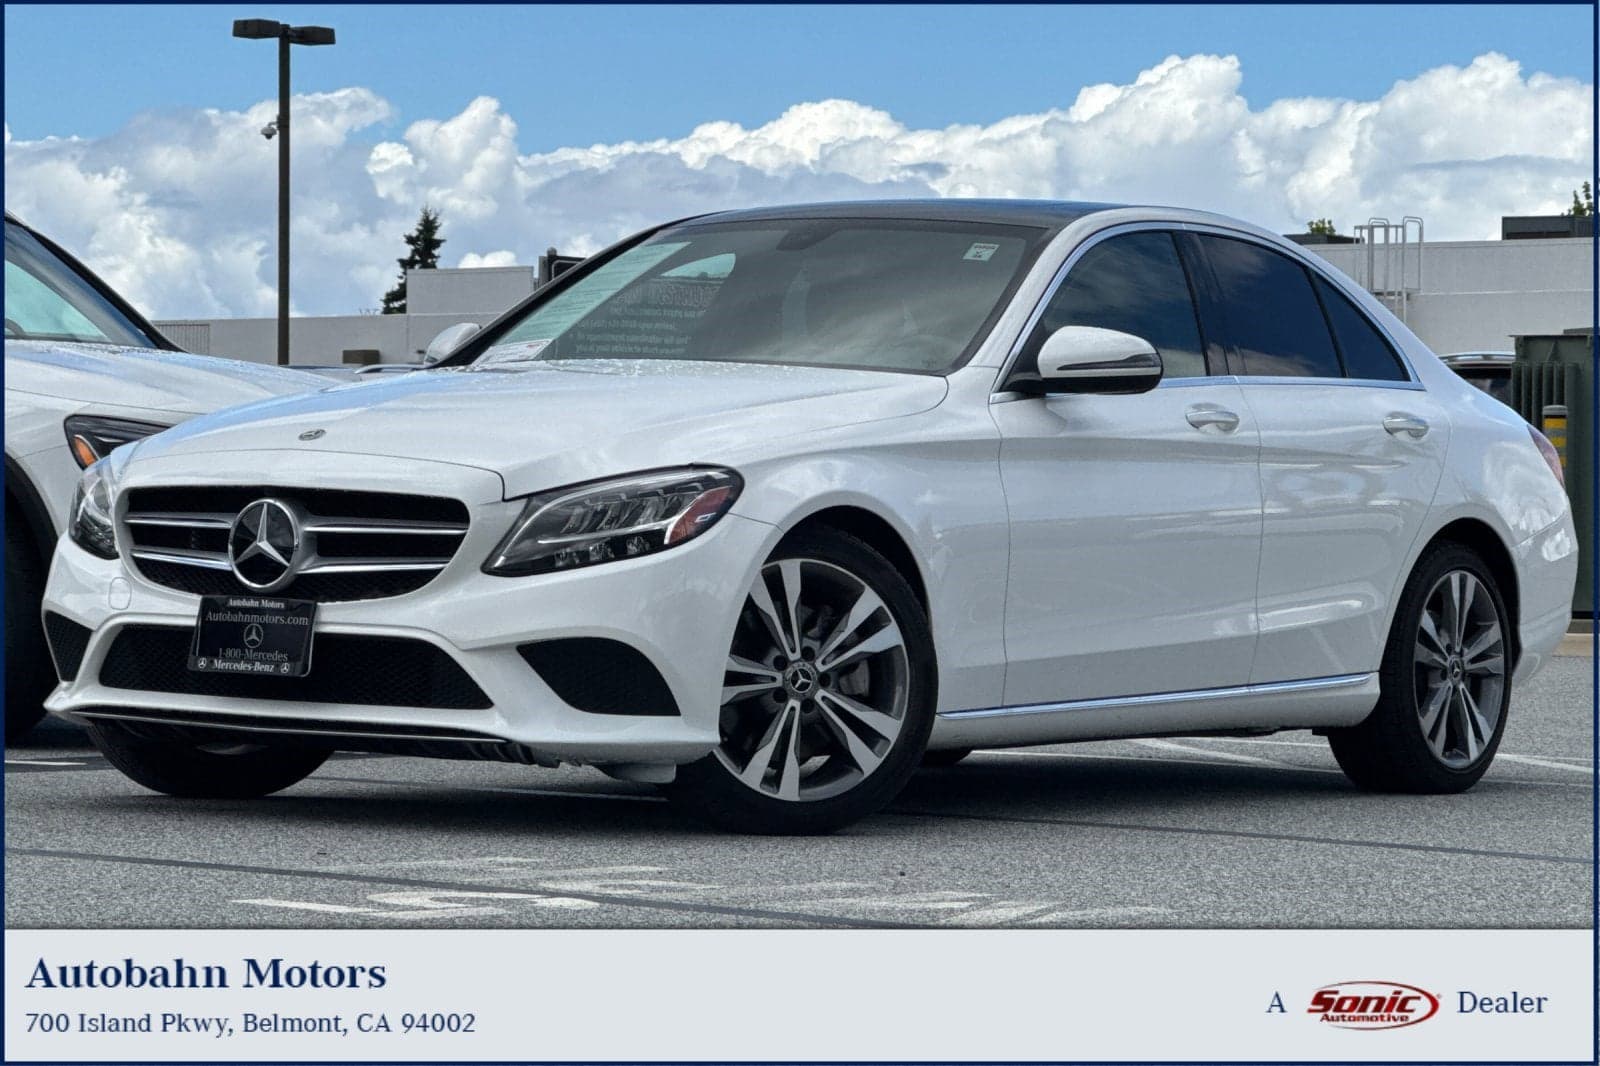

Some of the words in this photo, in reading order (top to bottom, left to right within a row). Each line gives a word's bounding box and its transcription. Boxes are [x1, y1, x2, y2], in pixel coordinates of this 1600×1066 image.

[228, 598, 260, 608] Autobahn
[261, 599, 285, 609] Motors
[206, 612, 309, 625] Autobahnmotors.com
[219, 648, 288, 661] 1-800-Mercedes
[213, 659, 275, 672] Mercedes-Benz
